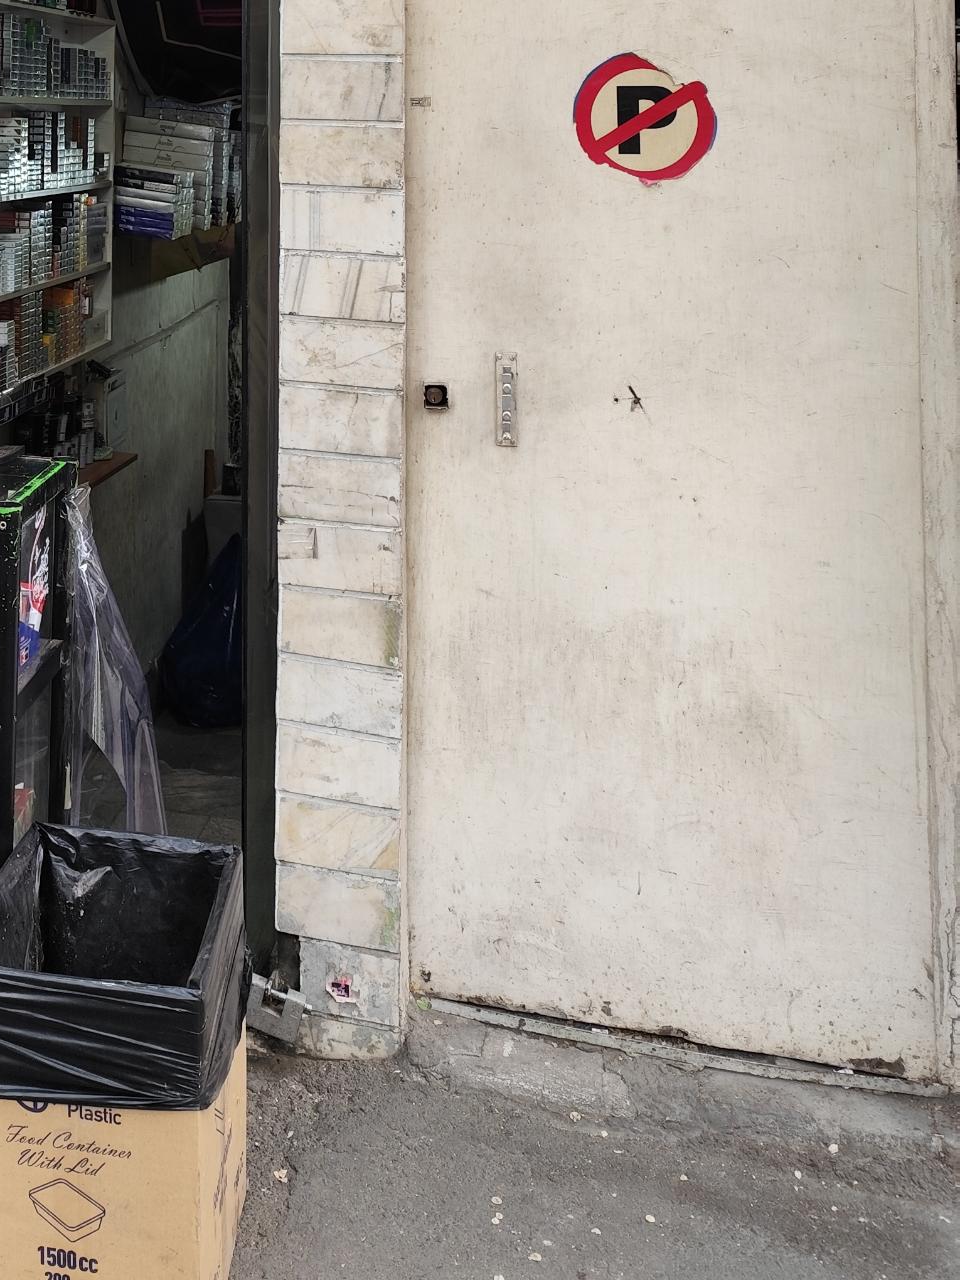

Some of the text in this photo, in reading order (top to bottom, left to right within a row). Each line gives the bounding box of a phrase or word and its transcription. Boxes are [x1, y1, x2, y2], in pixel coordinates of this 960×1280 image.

[67, 1104, 122, 1125] Plastic
[5, 1124, 132, 1161] Food Container
[16, 1148, 102, 1178] With Lid
